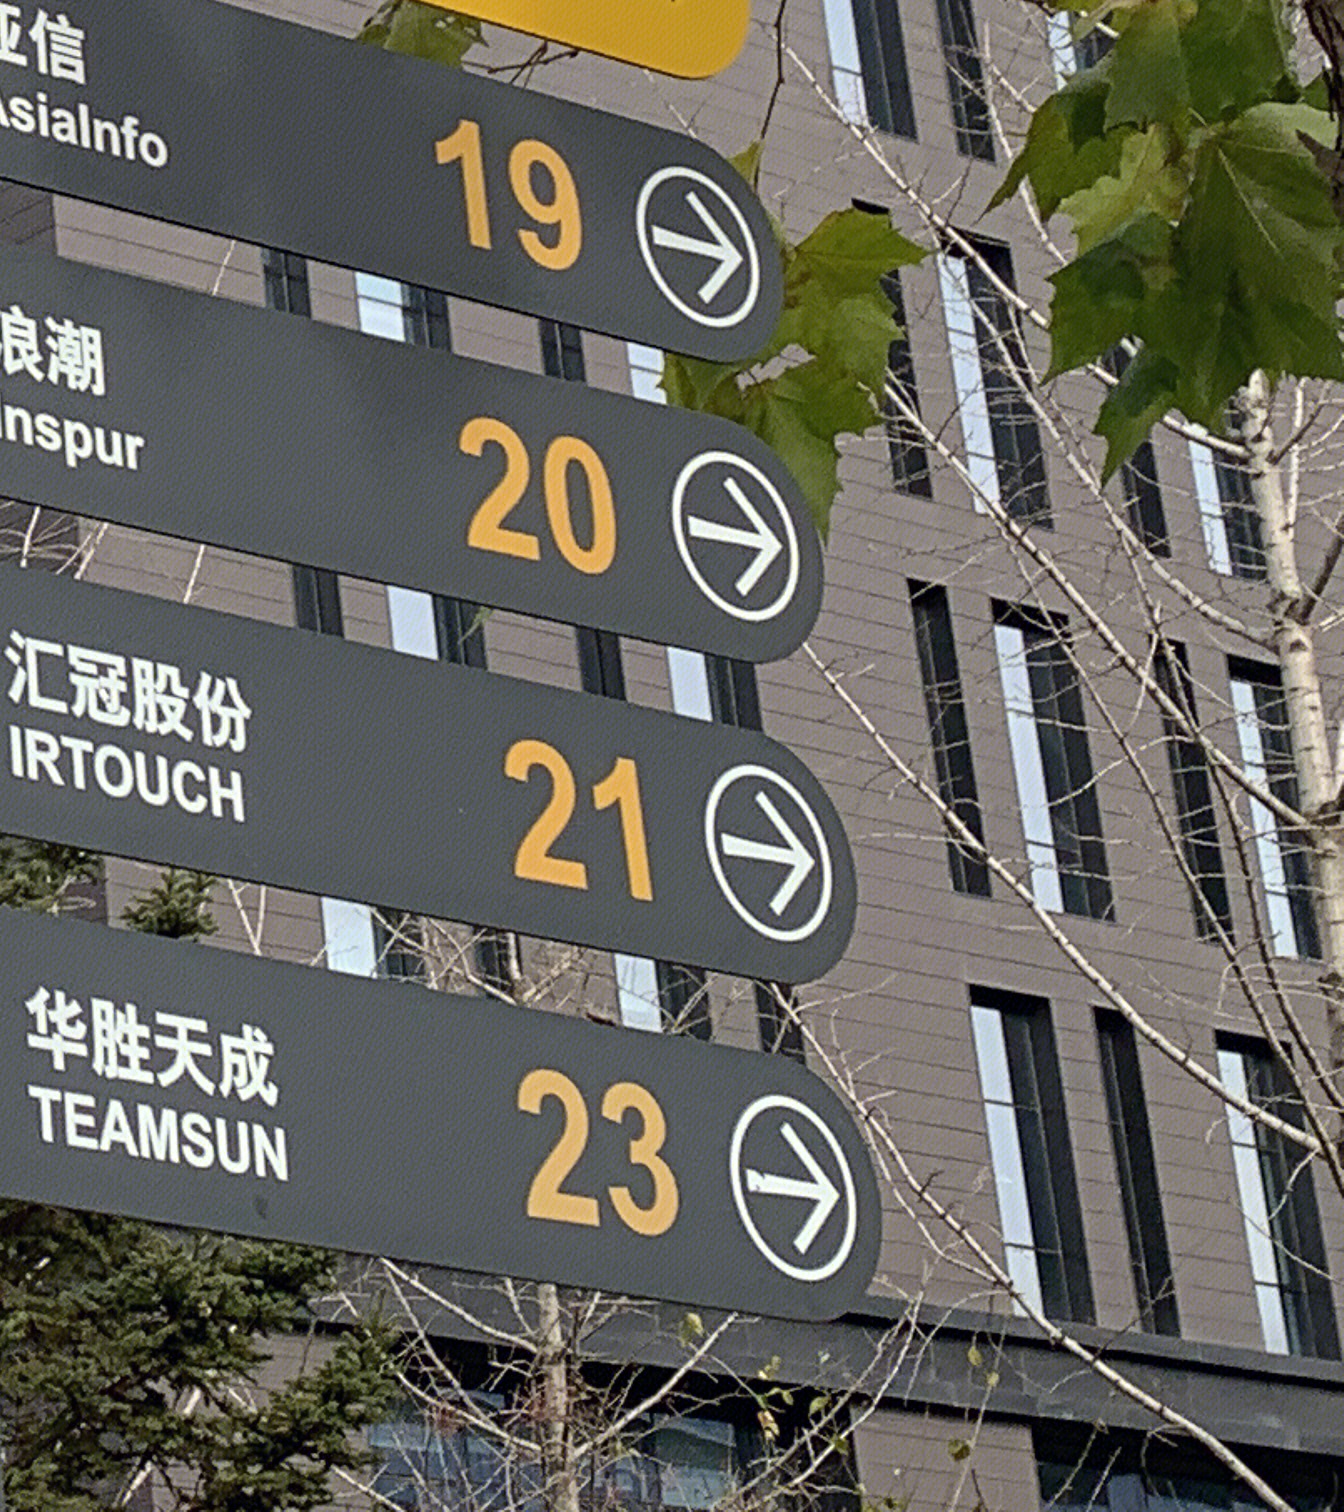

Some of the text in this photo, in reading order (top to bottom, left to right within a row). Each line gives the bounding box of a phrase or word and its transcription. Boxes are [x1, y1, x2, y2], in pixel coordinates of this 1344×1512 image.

[435, 119, 583, 271] 19
[458, 416, 618, 576] 20
[4, 628, 253, 754] 汇冠股份
[8, 724, 247, 824] IRTOUCH
[504, 738, 654, 902] 21
[25, 986, 280, 1109] 华胜天成
[27, 1084, 291, 1182] TEAMSUN
[518, 1068, 680, 1237] 23
